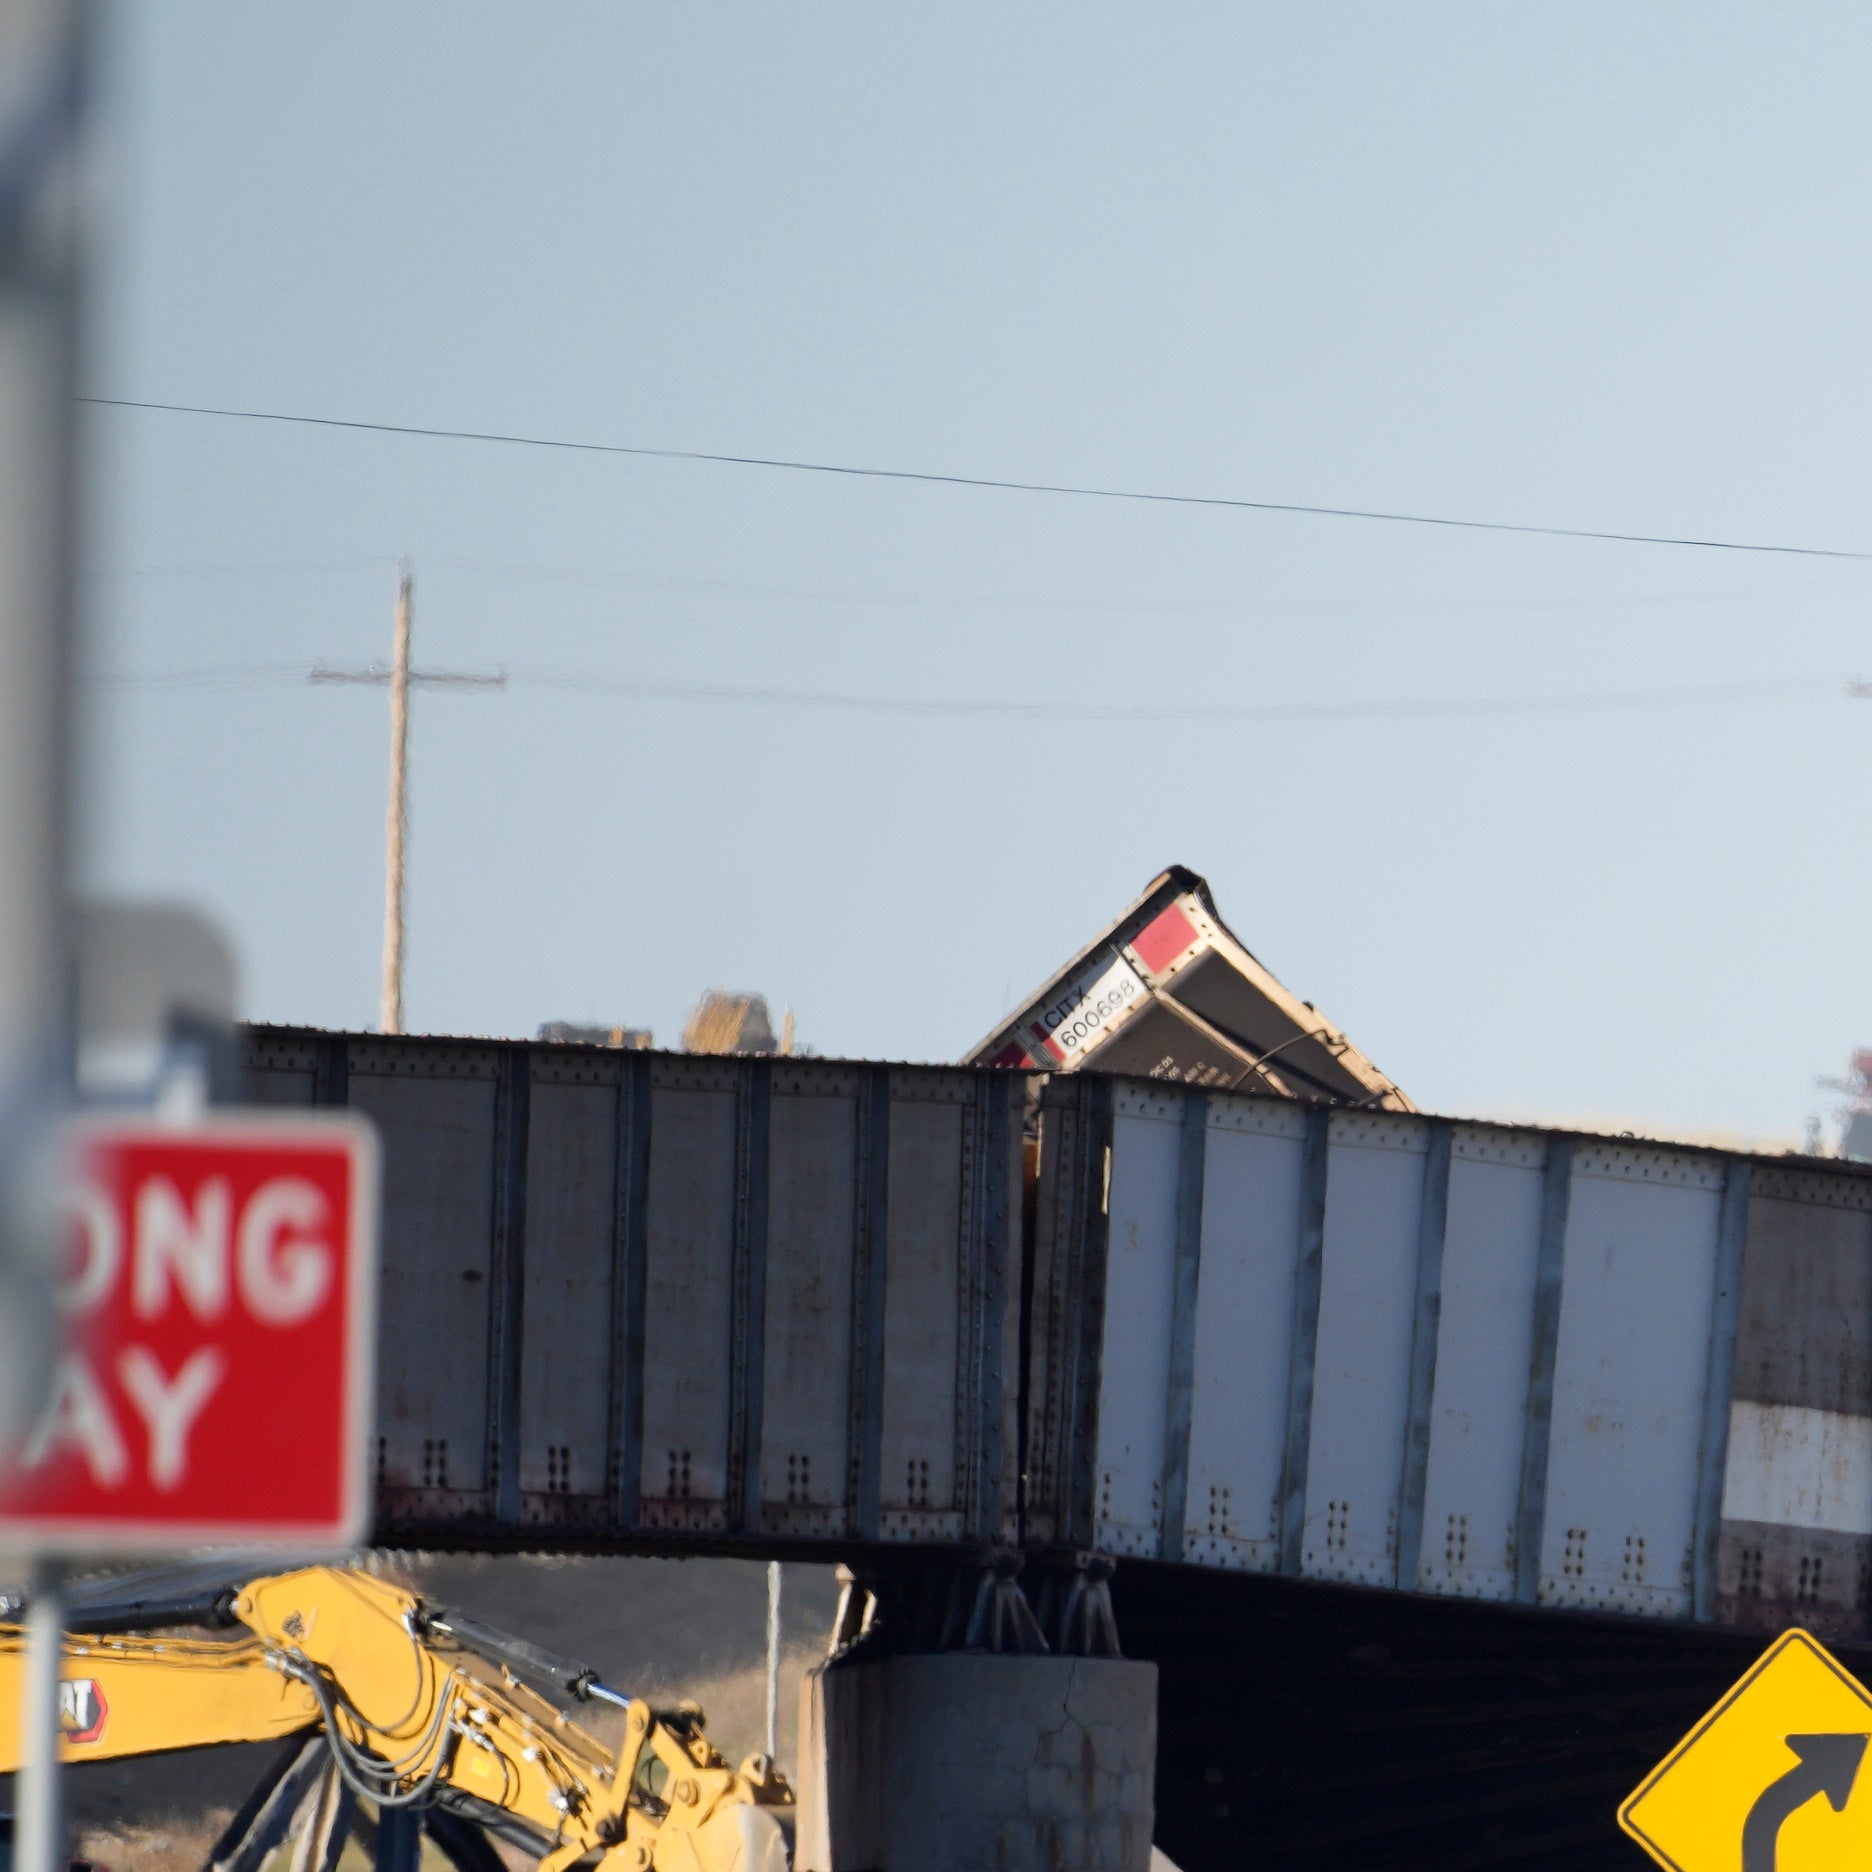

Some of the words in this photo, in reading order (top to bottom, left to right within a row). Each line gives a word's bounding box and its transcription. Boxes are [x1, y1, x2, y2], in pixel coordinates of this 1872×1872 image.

[1044, 986, 1090, 1030] CITX
[1061, 980, 1135, 1048] 600698
[45, 1172, 334, 1327] ONG
[22, 1345, 227, 1491] AY
[59, 1679, 92, 1730] AT
